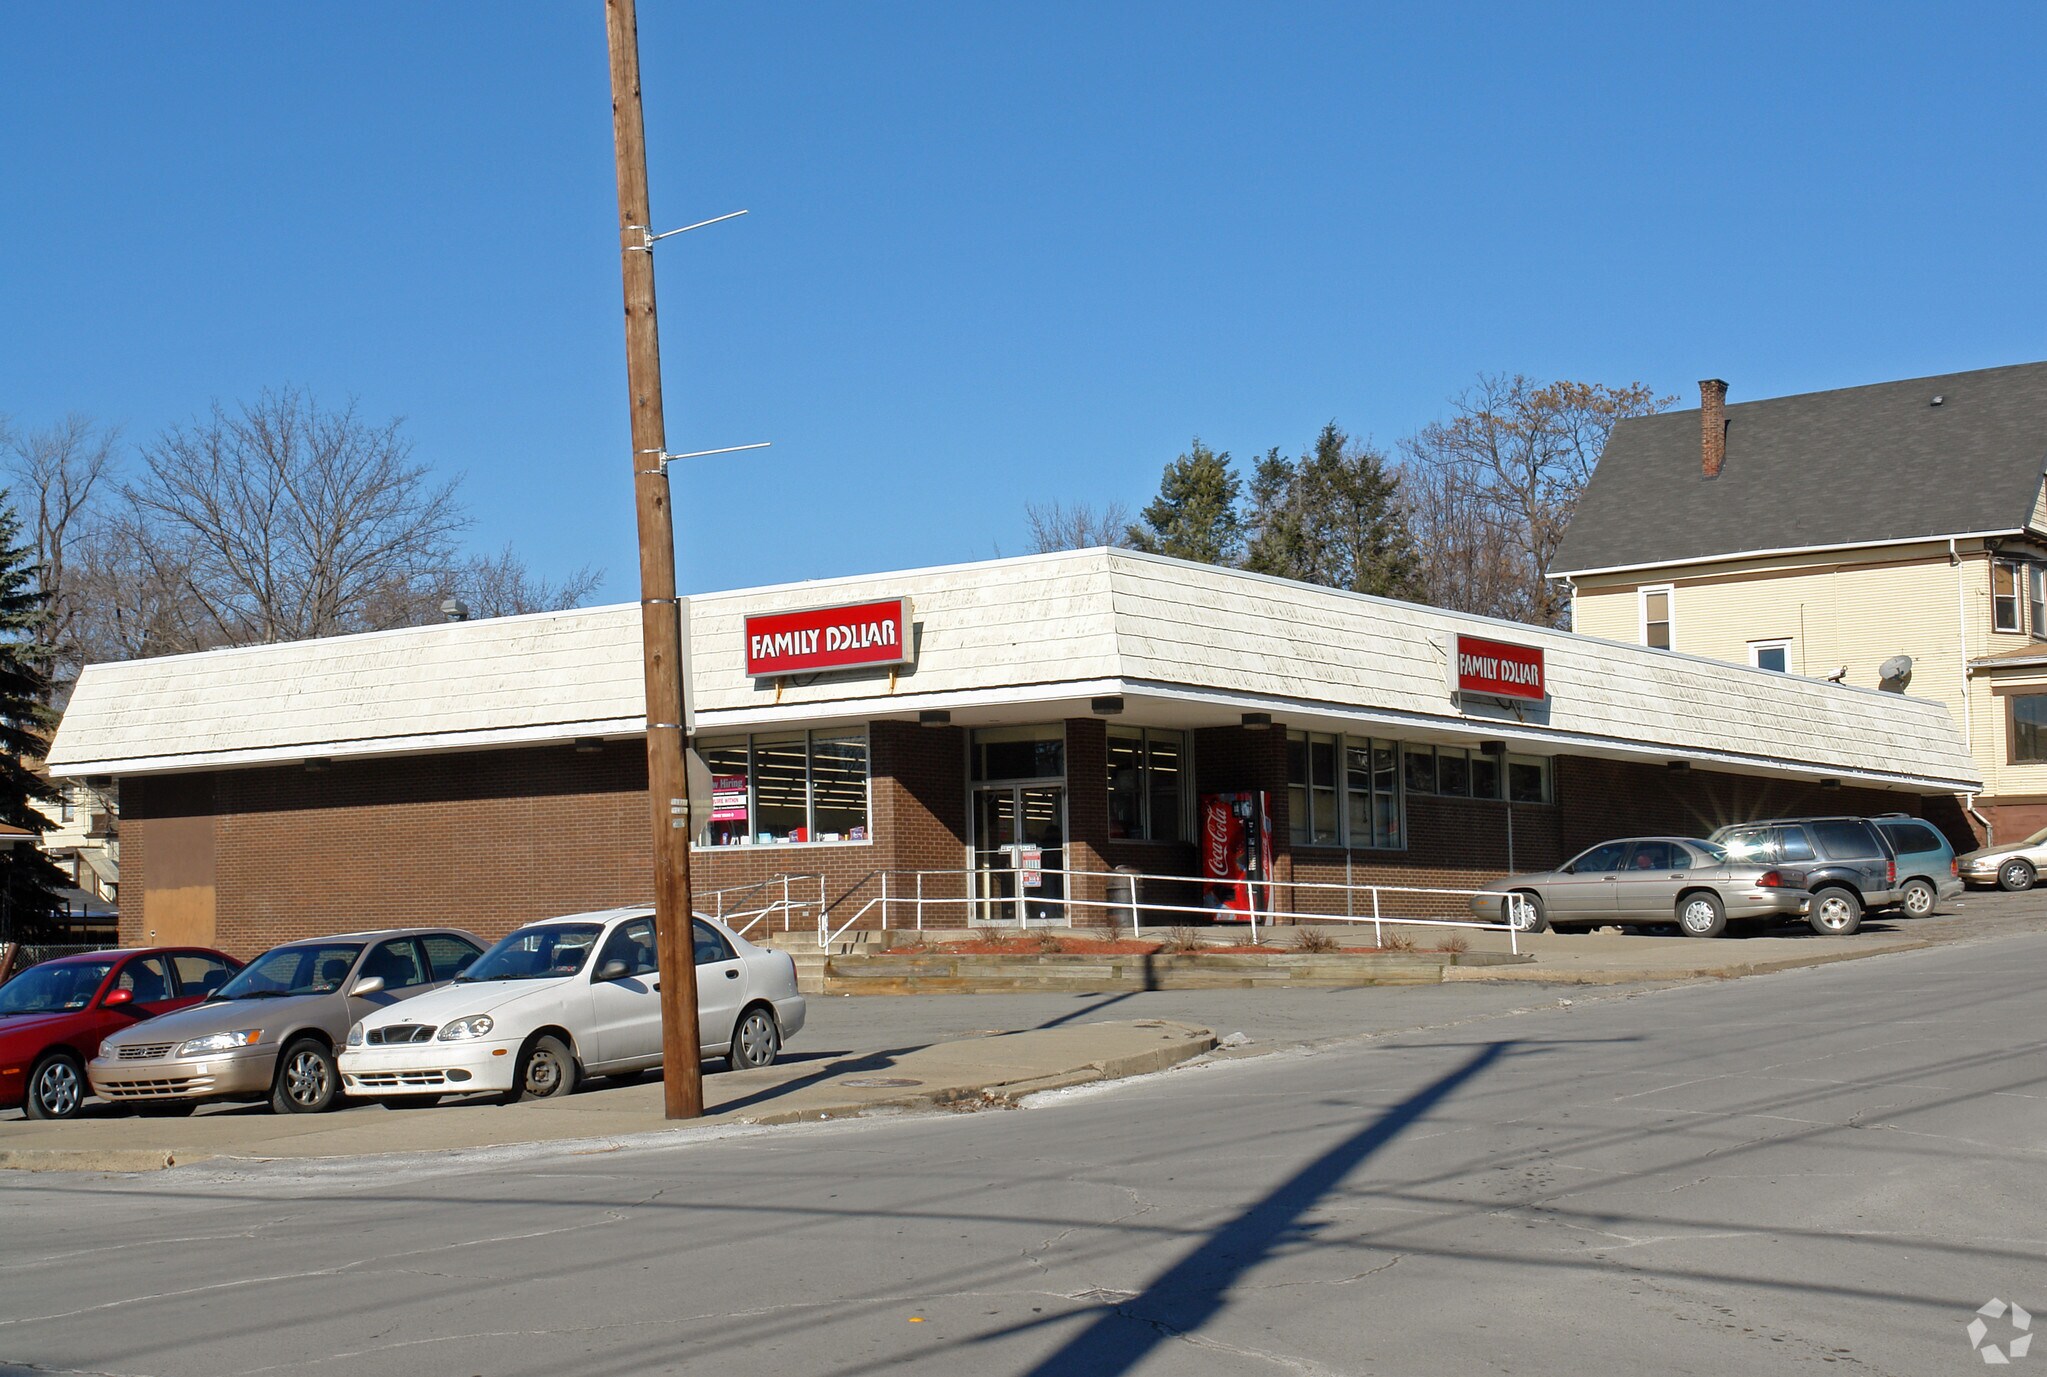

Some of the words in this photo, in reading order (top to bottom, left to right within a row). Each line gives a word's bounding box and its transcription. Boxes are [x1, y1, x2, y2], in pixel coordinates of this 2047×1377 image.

[751, 628, 820, 660] FAMILY
[825, 619, 895, 652] DOLLAR
[1459, 653, 1498, 680] FAMILY
[1500, 659, 1539, 687] DOLLAR
[720, 778, 743, 789] Hiring
